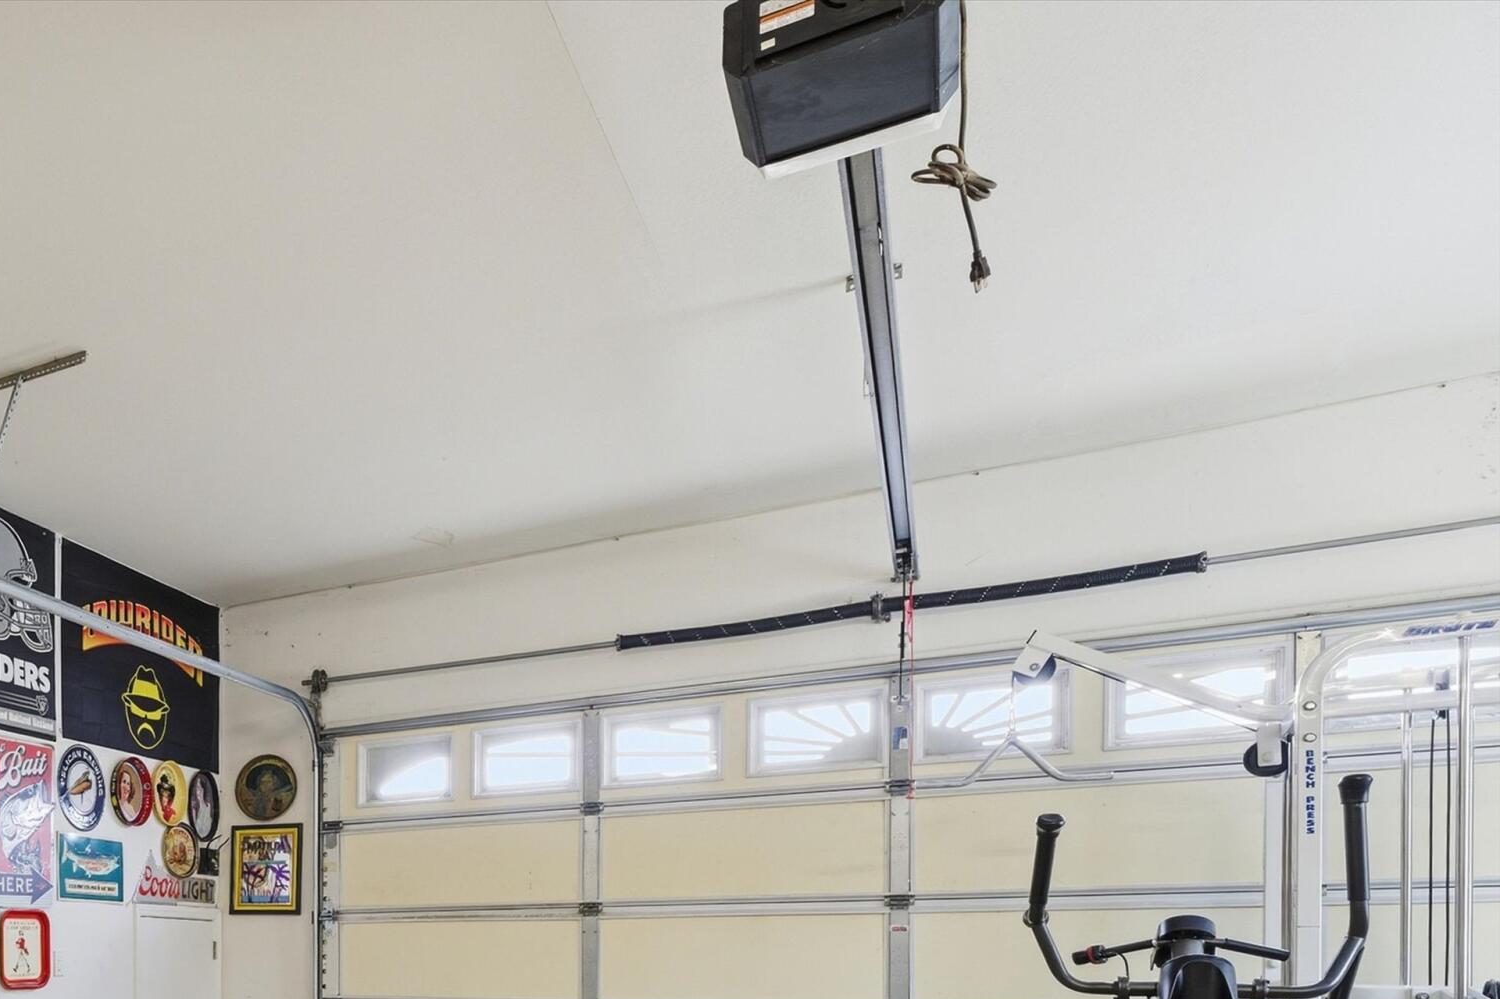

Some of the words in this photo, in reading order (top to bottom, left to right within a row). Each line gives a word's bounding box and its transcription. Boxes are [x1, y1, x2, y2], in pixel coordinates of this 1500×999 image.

[1305, 750, 1316, 788] BENCH
[1306, 796, 1315, 834] PRESS
[138, 865, 181, 899] Coors
[181, 878, 214, 900] LIGHT
